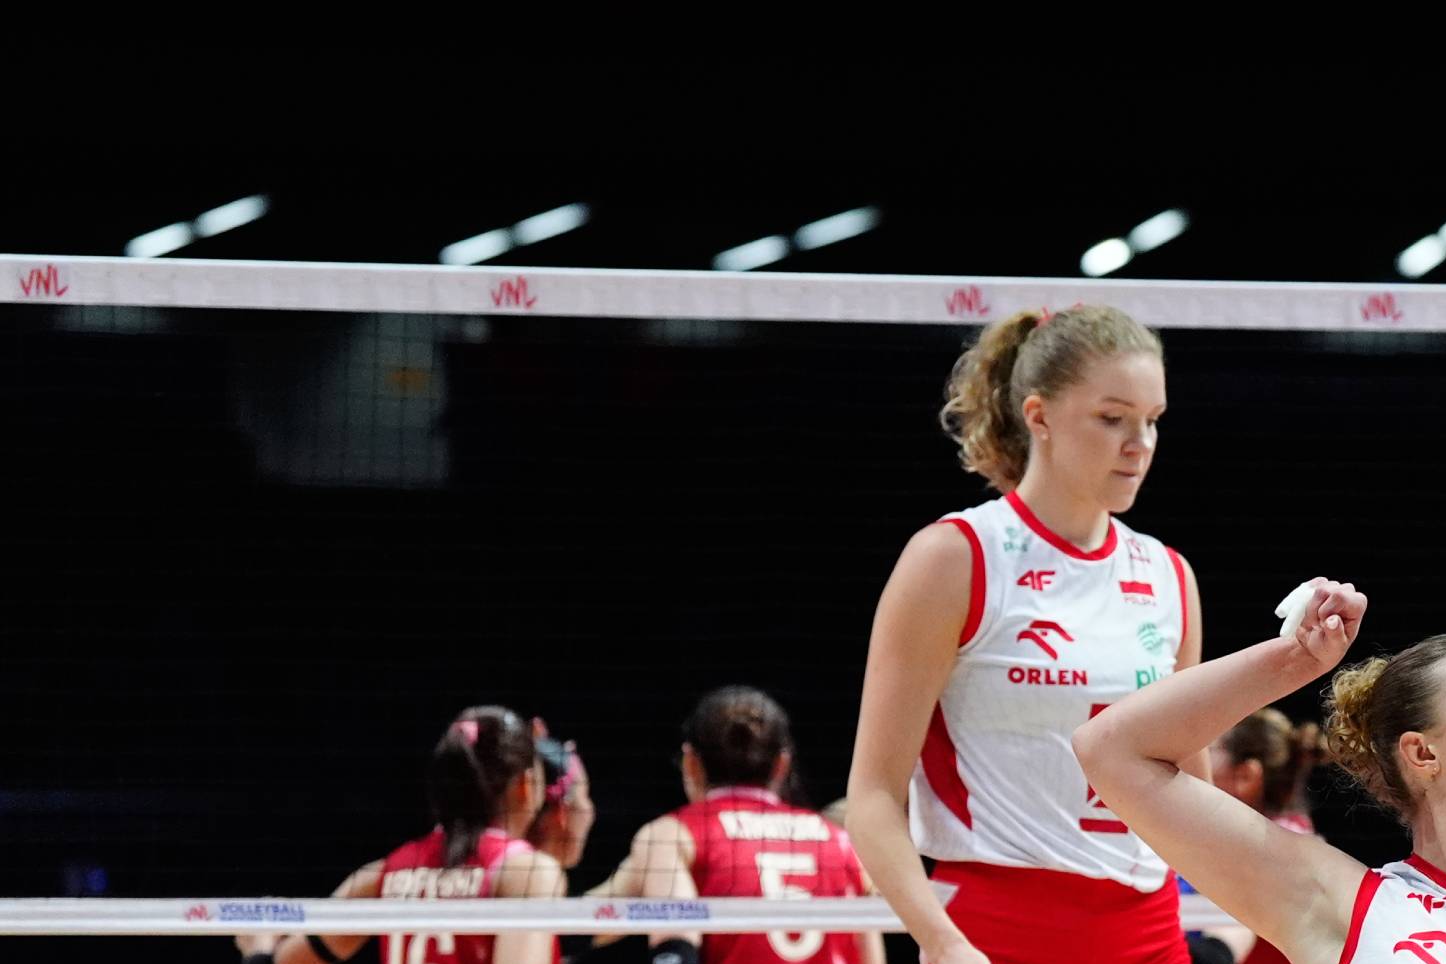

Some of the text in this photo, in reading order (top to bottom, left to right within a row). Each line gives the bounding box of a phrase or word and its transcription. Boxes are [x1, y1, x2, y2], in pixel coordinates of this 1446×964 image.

[19, 264, 68, 297] VNL
[491, 275, 536, 309] VNL
[944, 285, 989, 316] VNL
[1359, 292, 1402, 321] VNL
[1016, 570, 1055, 591] 4F
[1008, 667, 1088, 686] ORLEN
[755, 852, 826, 962] 5
